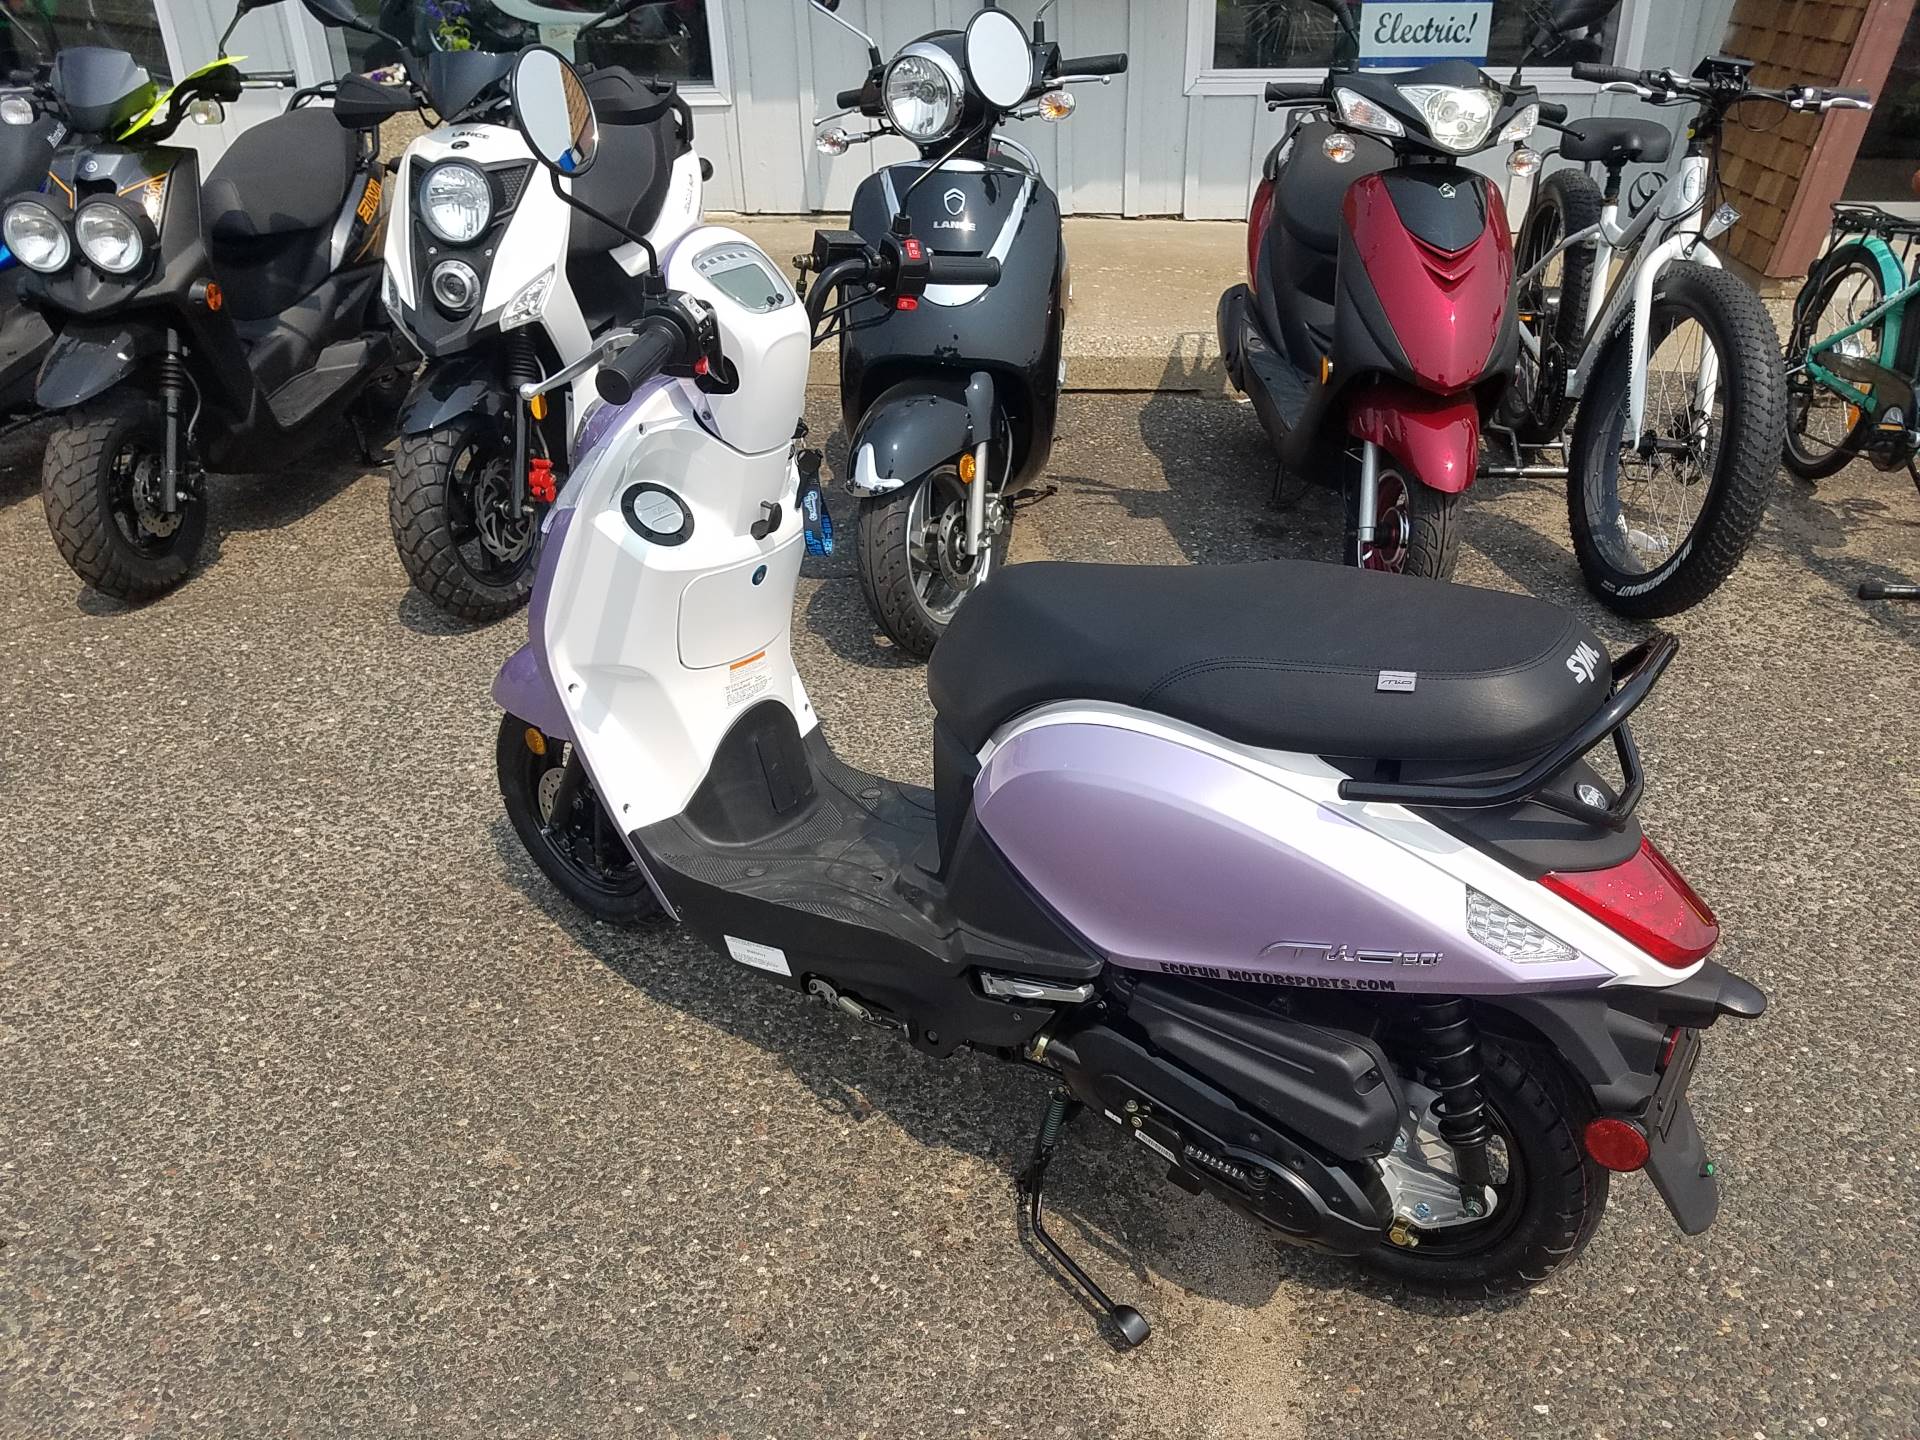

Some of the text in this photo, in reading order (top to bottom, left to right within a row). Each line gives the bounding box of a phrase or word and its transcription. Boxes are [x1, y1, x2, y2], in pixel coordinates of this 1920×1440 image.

[1374, 12, 1478, 44] Electric!
[451, 131, 490, 140] LANCE
[1566, 640, 1600, 684] SYM
[1159, 962, 1396, 992] ECOFUN MOTORSPORTS.COM
